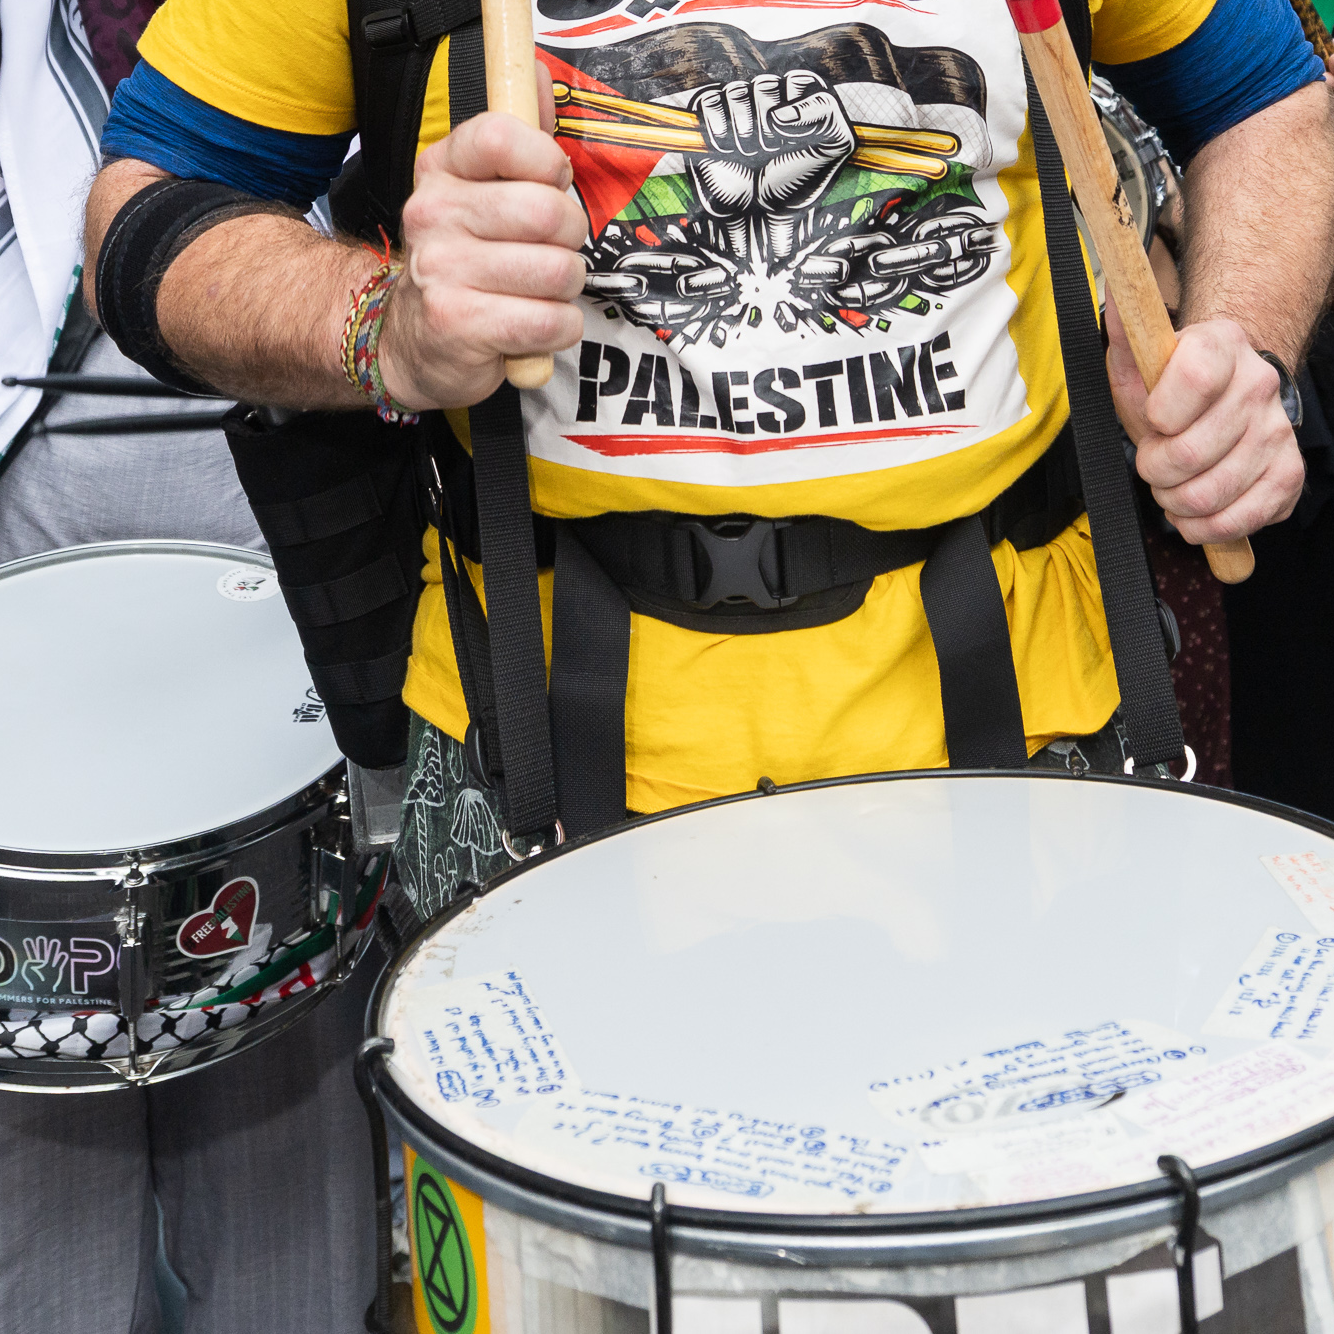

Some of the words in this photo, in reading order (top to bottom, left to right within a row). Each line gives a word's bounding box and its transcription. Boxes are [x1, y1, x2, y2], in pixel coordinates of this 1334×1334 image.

[574, 330, 966, 435] PALESTINE
[35, 995, 57, 1005] FOR
[58, 996, 112, 1007] PALESTINE
